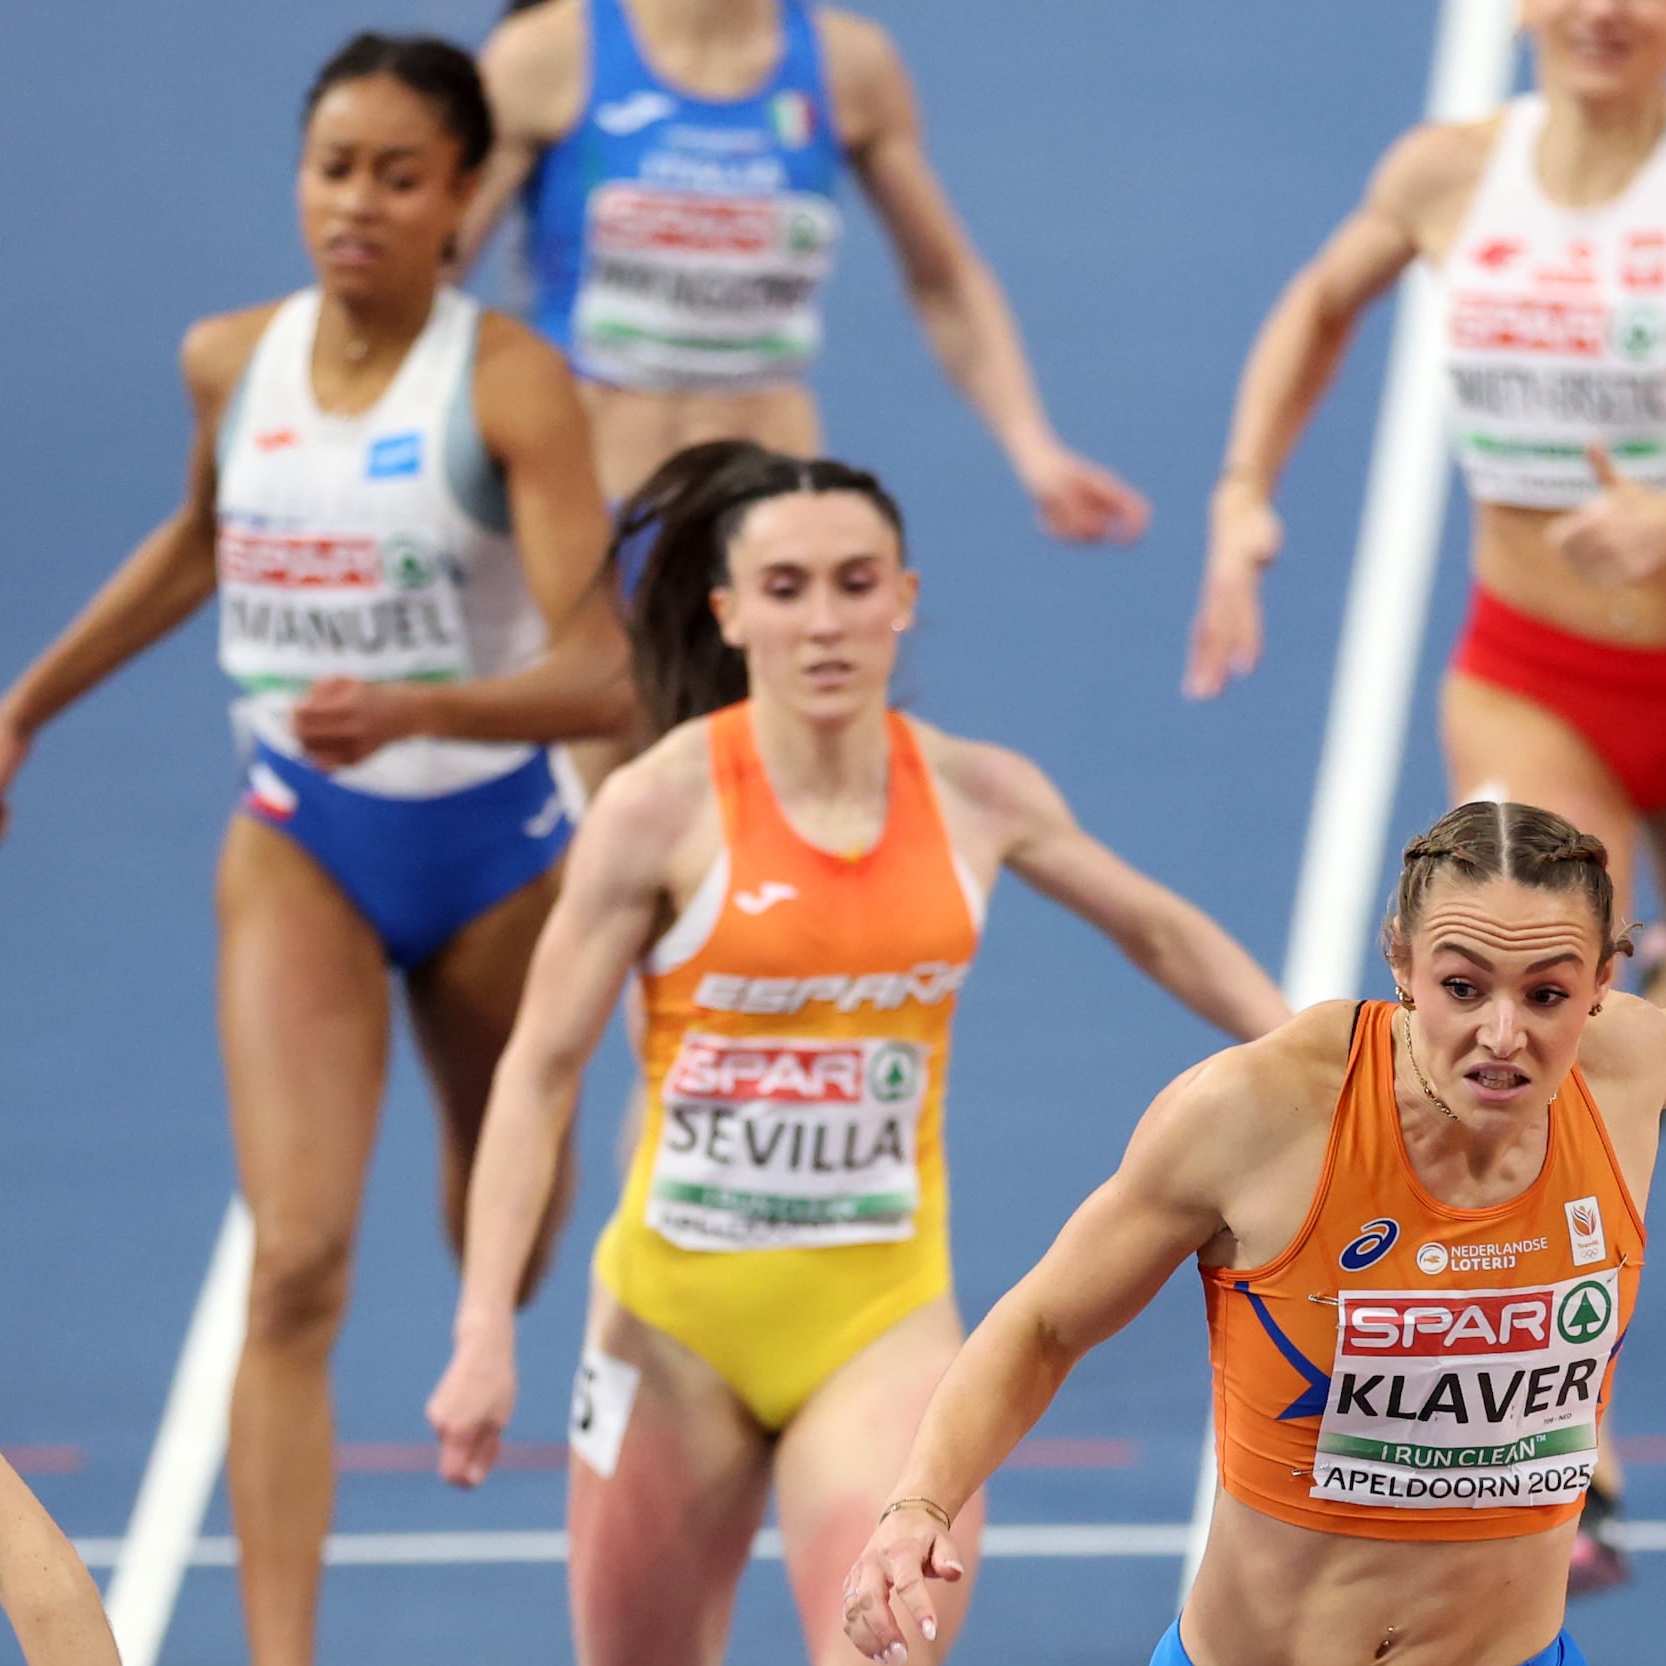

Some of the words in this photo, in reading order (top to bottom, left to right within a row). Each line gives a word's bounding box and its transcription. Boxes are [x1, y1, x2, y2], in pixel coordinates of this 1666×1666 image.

[231, 599, 453, 654] MANUEL
[677, 1049, 859, 1098] SPAR
[668, 1102, 906, 1174] SEVILLA
[1451, 1237, 1548, 1258] NEDERLANDSE
[1451, 1255, 1516, 1271] LOTERIJ
[1349, 1300, 1546, 1349] SPAR
[1335, 1358, 1598, 1424] KLAVER
[1381, 1444, 1388, 1461] I
[1394, 1444, 1454, 1468] RUN
[1324, 1466, 1520, 1499] APELDOORN
[1528, 1463, 1592, 1495] 2025
